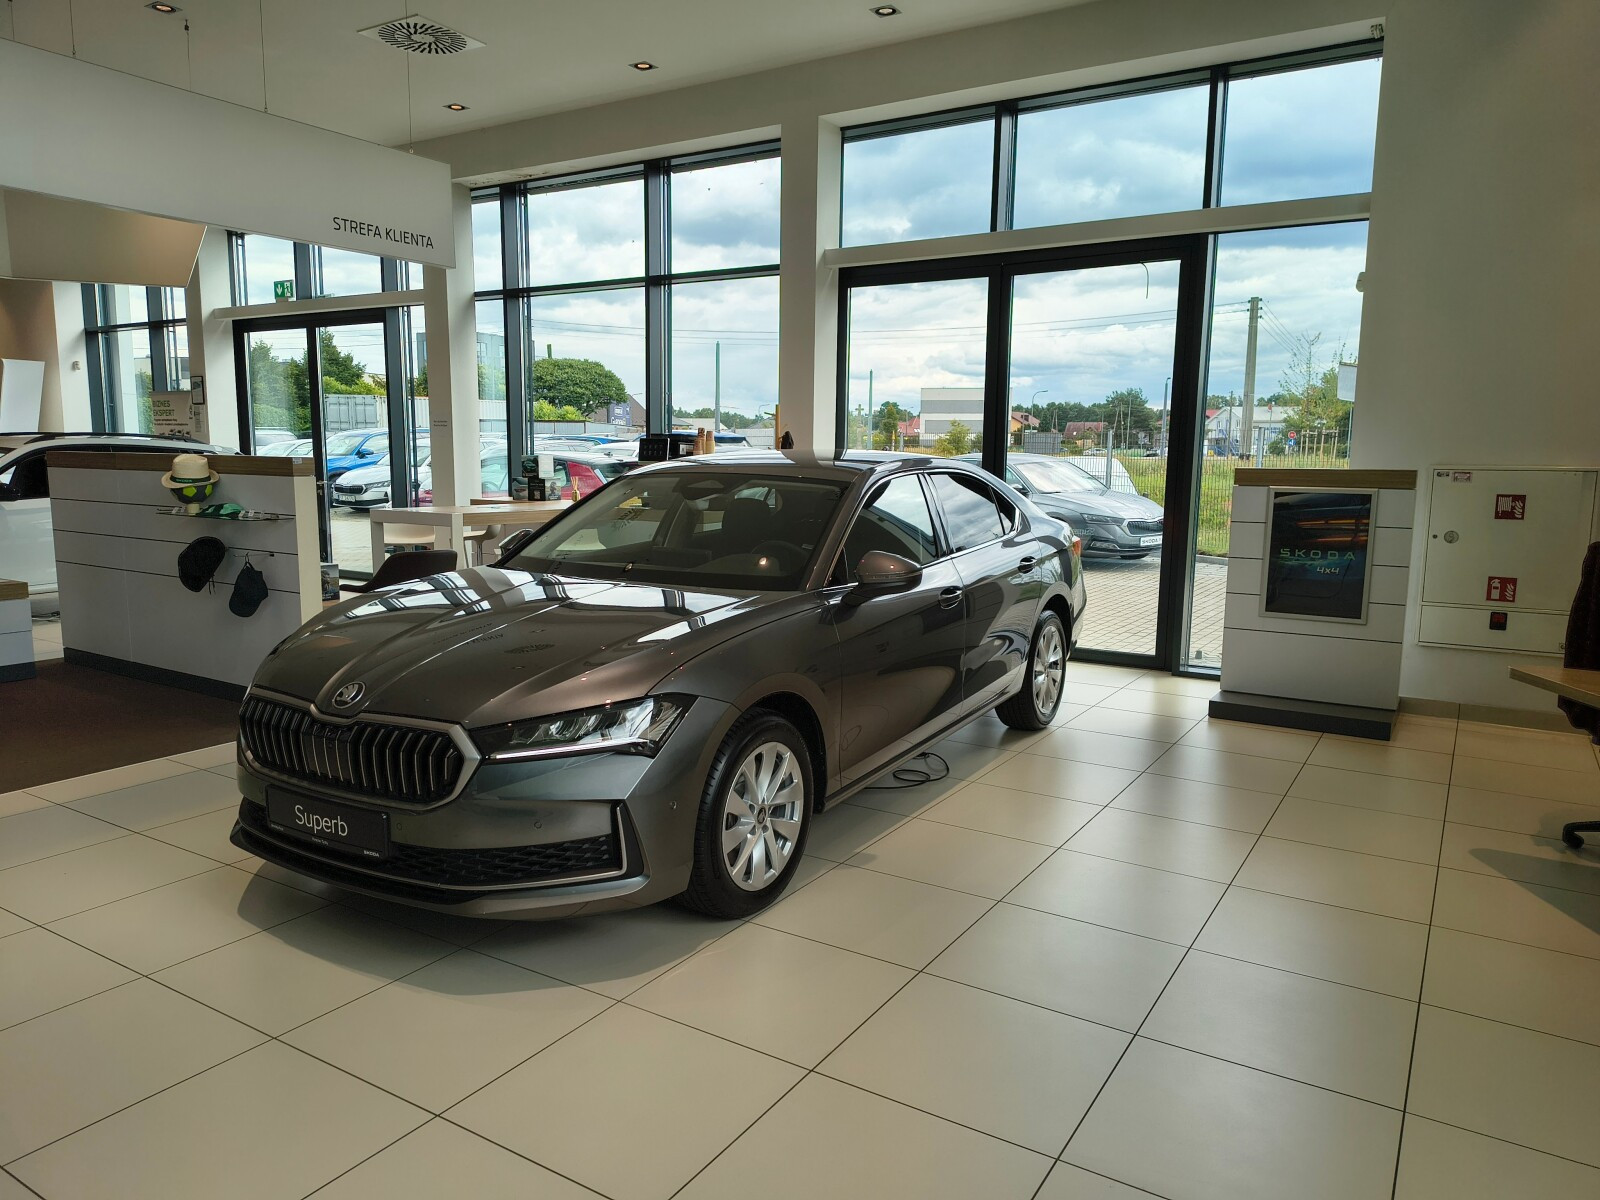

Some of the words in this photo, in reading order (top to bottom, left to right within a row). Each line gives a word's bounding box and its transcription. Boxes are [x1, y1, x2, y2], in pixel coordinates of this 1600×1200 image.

[333, 216, 382, 239] STREFA
[385, 227, 434, 249] KLIENTA
[1316, 566, 1340, 574] 4x4
[295, 805, 348, 836] Superb
